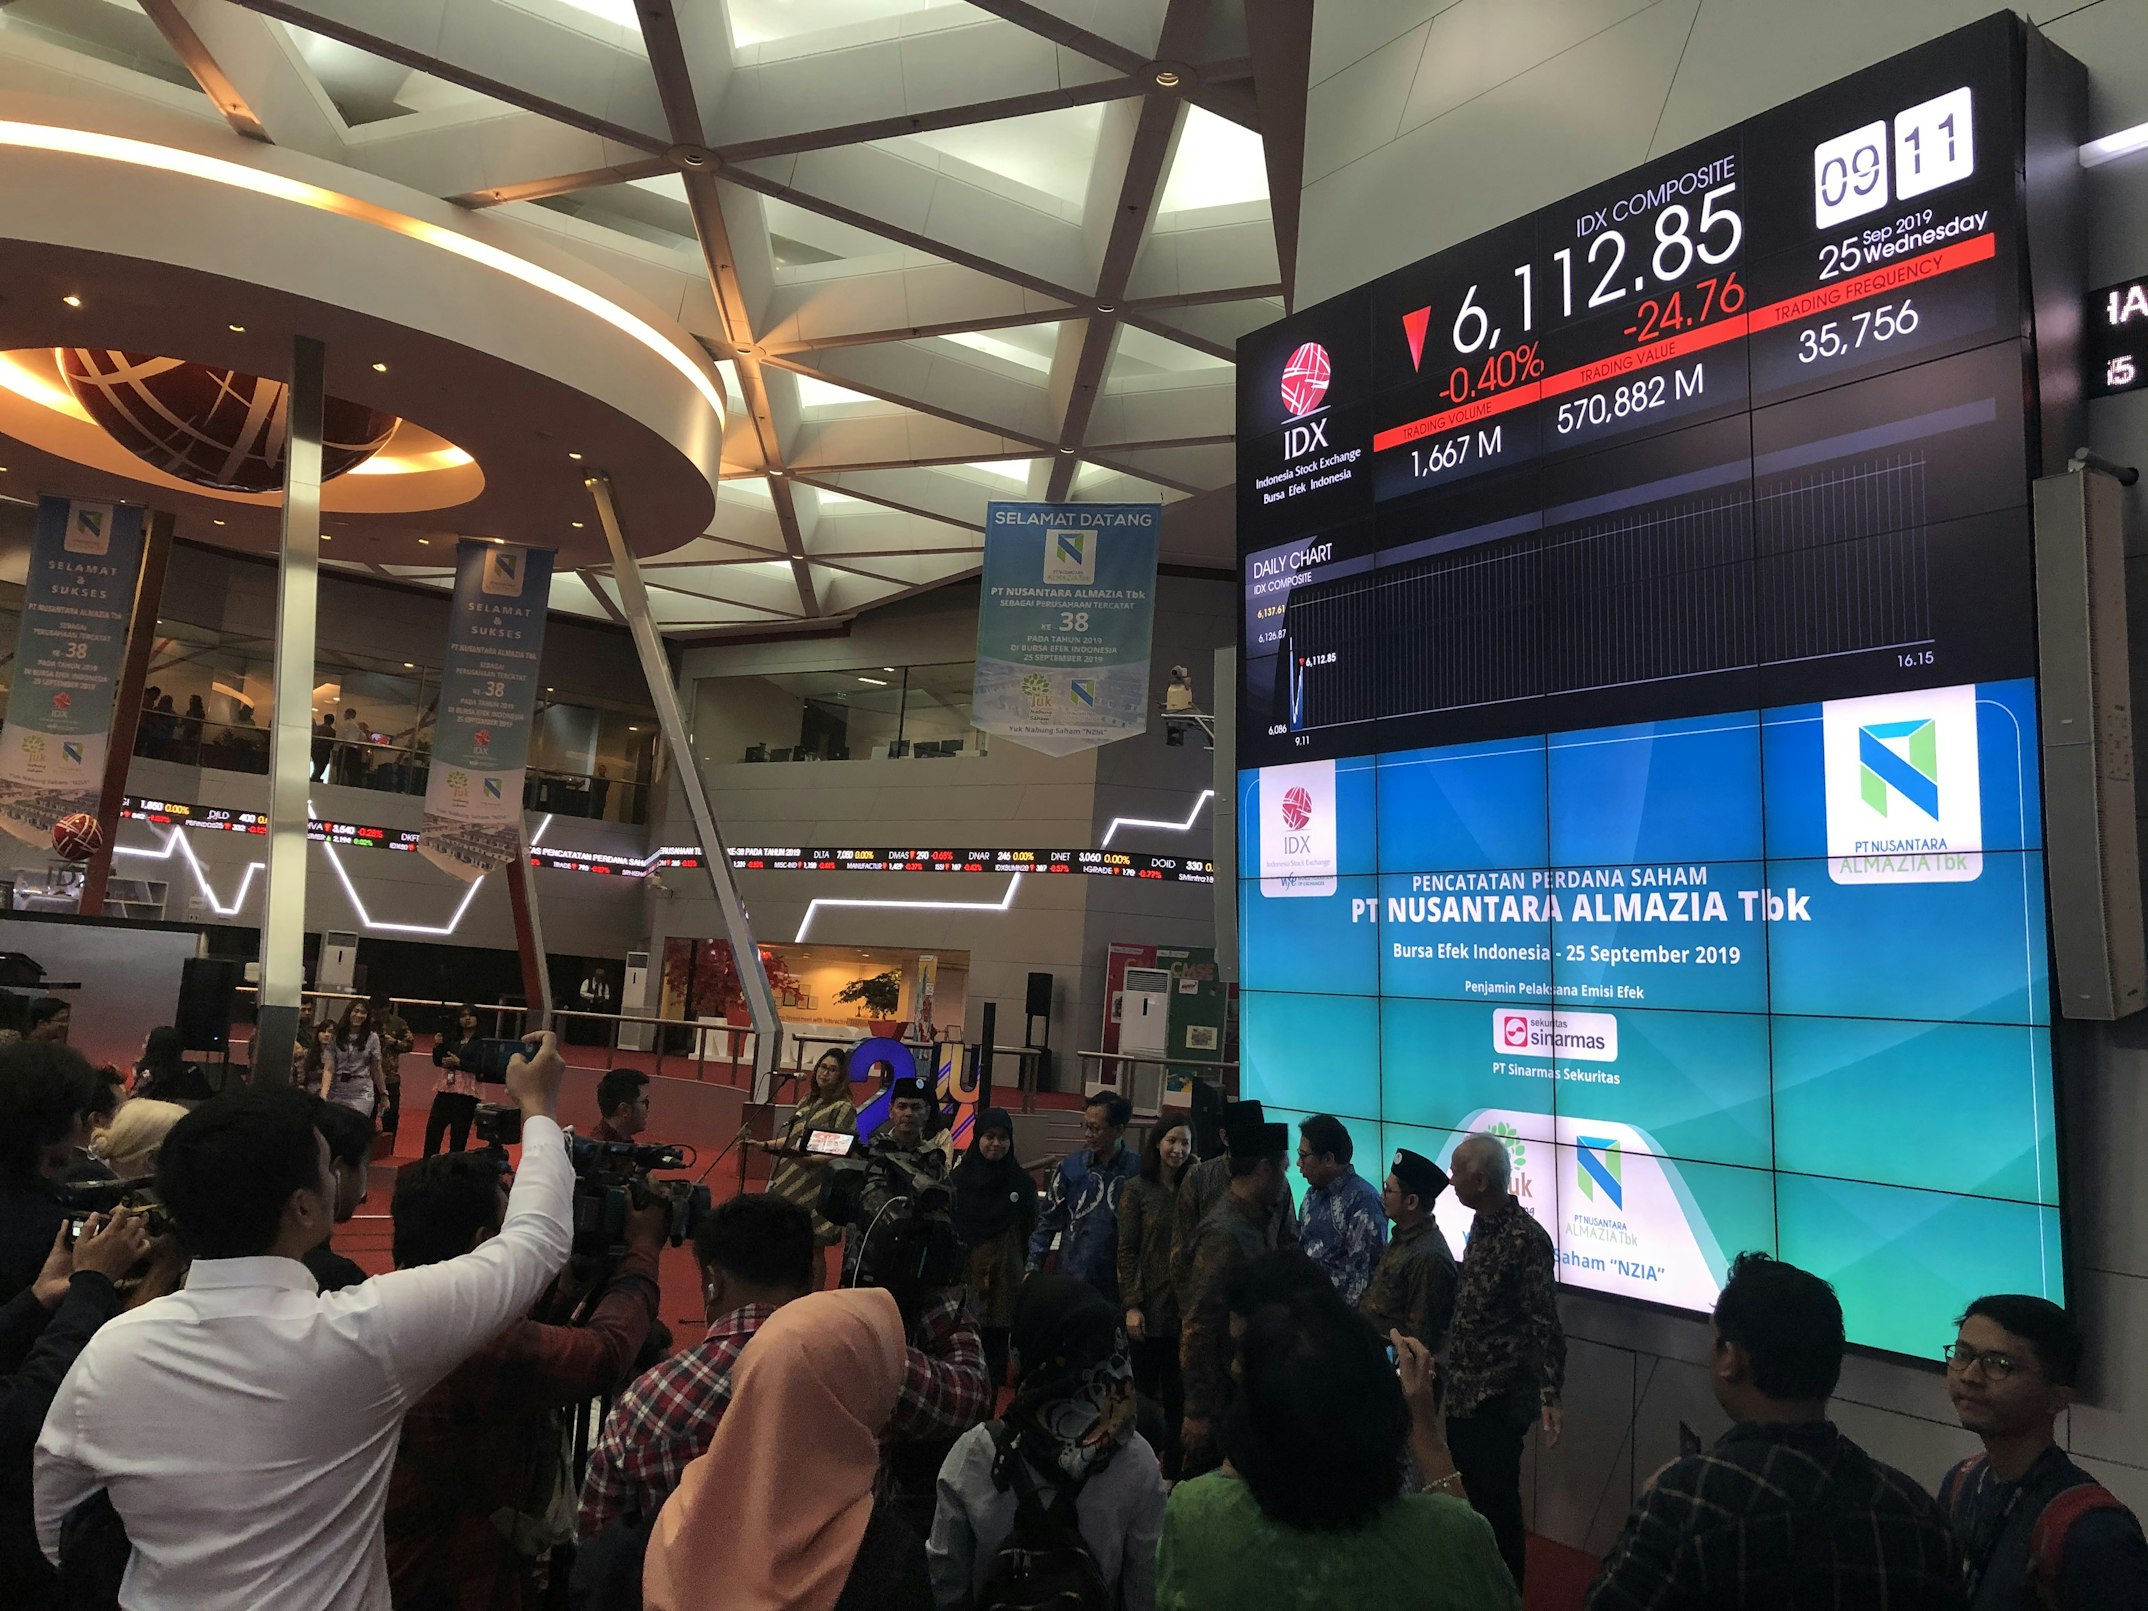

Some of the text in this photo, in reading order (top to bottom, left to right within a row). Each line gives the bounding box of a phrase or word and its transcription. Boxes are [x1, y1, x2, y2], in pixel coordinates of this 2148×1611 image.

[1904, 111, 1957, 174] 11
[1820, 144, 1881, 208] 09
[1577, 155, 1736, 239] IDX COMPOSITE
[1818, 209, 1933, 281] 25 Sep 2019
[1864, 211, 1988, 263] Wednesday
[1452, 182, 1743, 354] 6,112.85
[1775, 256, 1943, 322] TRADING FREQUENCY
[1623, 272, 1745, 344] -24.76
[1798, 300, 1919, 364] 35,756
[1439, 341, 1544, 404] -0.40%
[1580, 342, 1677, 383] TRADING VALUE
[1557, 363, 1704, 434] 570,882 M
[1403, 402, 1492, 440] TRADING VOLUME
[1284, 418, 1328, 460] IDX
[1410, 426, 1501, 478] 1,667 M
[1256, 448, 1361, 490] Indonesia Stock Exchange
[1264, 468, 1352, 504] Bursa Efek Indonesia
[995, 512, 1152, 527] SELAMAT DATANG
[48, 560, 117, 576] SELAMAT
[1253, 543, 1333, 579] DAILY CHART
[51, 584, 107, 599] SUKSES
[991, 587, 1146, 599] PT NUSANTARA ALMAZIA Tbk
[1253, 572, 1312, 595] IDX COMPOSITE
[468, 602, 532, 617] SELAMAT
[1257, 604, 1286, 619] 6,137.61
[471, 625, 522, 639] SUKSES
[1058, 611, 1089, 632] 38
[1258, 629, 1287, 643] 6,126.87
[66, 642, 88, 659] 38
[1305, 652, 1337, 667] 6,112.85
[1897, 651, 1934, 668] 16.15
[484, 681, 505, 698] 38
[1268, 724, 1287, 736] 6,086
[1295, 736, 1310, 746] 9.11
[542, 847, 592, 861] PENCATATAN
[1284, 835, 1310, 856] IDX
[1855, 838, 1948, 853] PT NUSANTARA
[888, 851, 909, 859] DMAS
[916, 851, 929, 860] 290
[968, 852, 990, 860] DNAR
[1012, 852, 1034, 861] 0.00%
[1050, 852, 1071, 861] DNET
[1103, 853, 1131, 865] 0.00%
[1151, 858, 1176, 869] DOID
[1185, 861, 1203, 871] 330
[1840, 853, 1968, 874] ALMAZIA Tbk
[1412, 866, 1708, 892] PENCATATAN PERDANA SAHAM
[1351, 887, 1812, 923] PT NUSANTARA ALMAZIA Tbk
[1393, 943, 1434, 960] Bursa
[1437, 943, 1470, 960] Efek
[1473, 943, 1551, 961] Indonesia
[1566, 945, 1586, 962] 25
[1590, 945, 1690, 966] September
[1695, 946, 1741, 964] 2019
[1464, 980, 1645, 999] Penjamin Pelaksana Emisi Efek
[1530, 1017, 1568, 1029] sekuritas
[1530, 1029, 1606, 1050] sinarmas
[1492, 1063, 1621, 1085] PT Sinarmas Sekuritas
[1574, 1214, 1628, 1231] PT NUSANTARA
[1565, 1223, 1638, 1247] ALMAZIA Tbk
[1553, 1248, 1606, 1271] Saham
